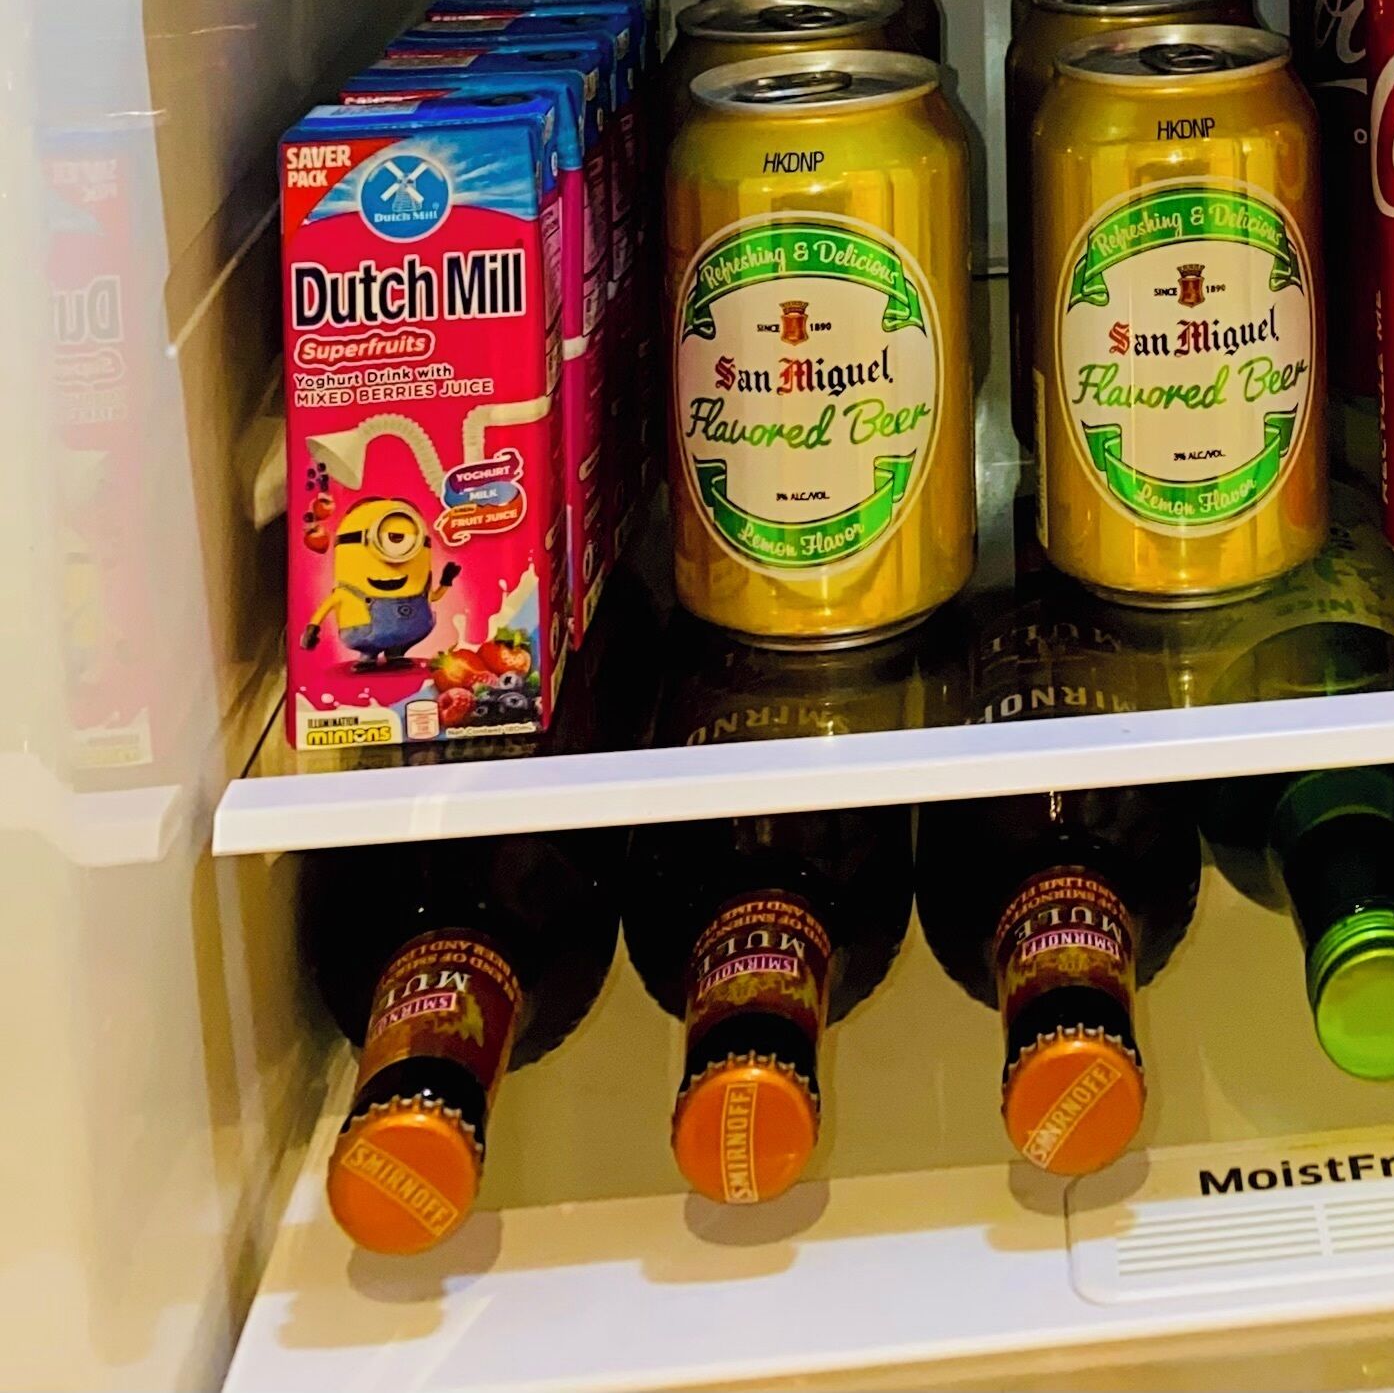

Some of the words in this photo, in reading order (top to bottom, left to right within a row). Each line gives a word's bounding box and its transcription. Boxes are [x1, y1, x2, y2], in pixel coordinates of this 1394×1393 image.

[1156, 117, 1216, 140] HKDNP
[286, 145, 352, 169] SAVER
[762, 150, 825, 174] HKDNP
[287, 169, 328, 188] PACK
[373, 212, 411, 224] Dutch
[1090, 210, 1183, 257] Refreshing
[1191, 206, 1205, 226] &
[1209, 205, 1282, 248] Delicious
[701, 244, 787, 290] Refreshing
[793, 241, 809, 262] &
[812, 240, 900, 285] Delicious
[293, 256, 436, 327] Dutch
[446, 252, 525, 316] Mill
[1153, 287, 1178, 297] SINCE
[757, 323, 781, 333] SINCE
[809, 322, 832, 332] 1890
[1108, 320, 1170, 358] San
[302, 335, 426, 361] Superfruits
[295, 373, 360, 390] Yoghurt
[367, 368, 412, 383] Drink
[417, 365, 452, 380] with
[714, 355, 772, 394] San
[1072, 362, 1230, 410] Flavored
[1238, 355, 1309, 403] Beer
[295, 391, 352, 406] MIXED
[359, 384, 435, 402] BERRIES
[441, 380, 493, 396] JUICE
[685, 397, 836, 450] Flavored
[843, 398, 932, 445] Beer
[456, 466, 511, 483] YOGHURT
[469, 489, 498, 502] MILK
[1135, 481, 1196, 516] Lemon
[1198, 478, 1257, 514] Flavor
[451, 514, 484, 528] FRUIT
[485, 508, 518, 523] JUICE
[737, 524, 798, 557] Lemon
[800, 523, 866, 555] Flavor
[1013, 906, 1123, 945] MULE
[1026, 932, 1115, 955] SMIRNOFF
[1028, 1067, 1111, 1162] SMIRNOFF
[727, 1084, 753, 1201] SMIRNOFF
[349, 1145, 449, 1228] SMIRNOFF
